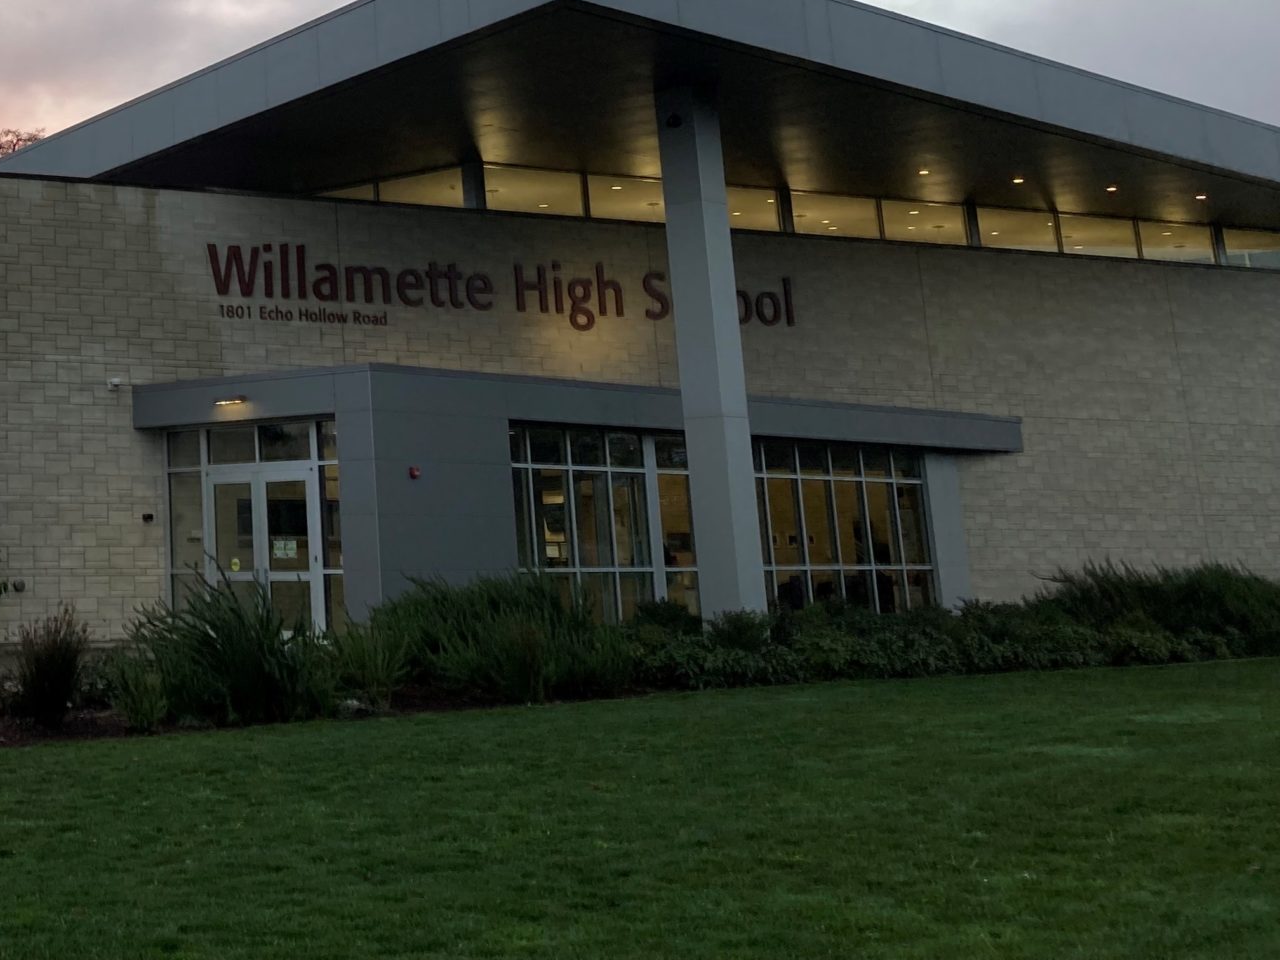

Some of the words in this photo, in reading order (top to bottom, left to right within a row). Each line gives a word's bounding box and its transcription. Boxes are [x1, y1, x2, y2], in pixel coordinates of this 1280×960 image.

[207, 243, 494, 311] Willamette
[513, 260, 624, 331] High
[642, 271, 796, 327] Sool
[219, 304, 252, 320] 1801
[259, 305, 293, 321] Echo
[298, 306, 348, 324] Hollow
[353, 310, 388, 326] Road
